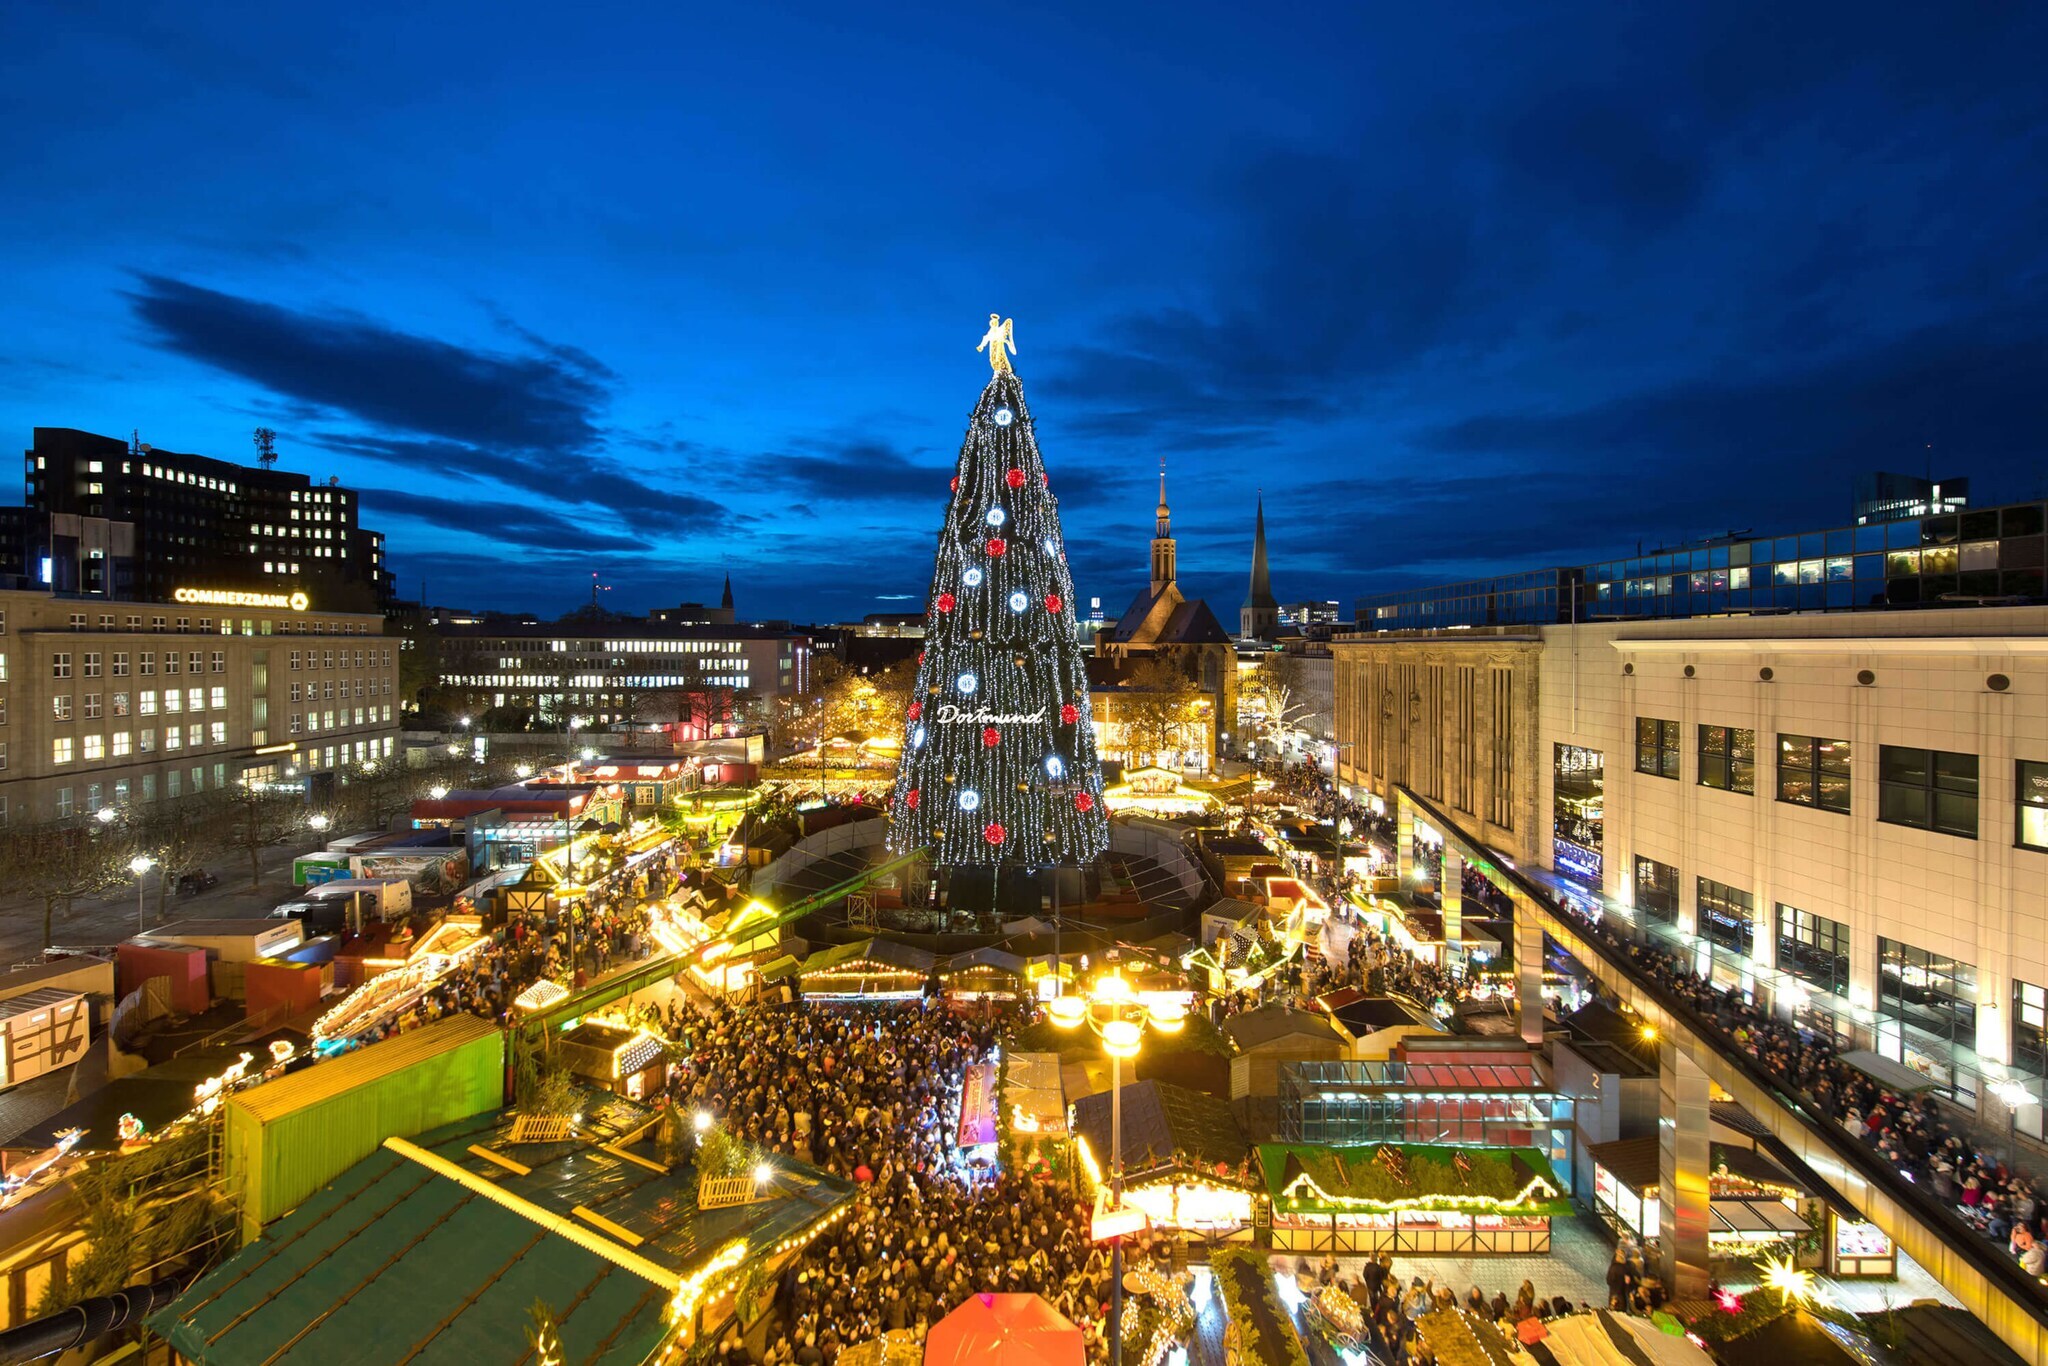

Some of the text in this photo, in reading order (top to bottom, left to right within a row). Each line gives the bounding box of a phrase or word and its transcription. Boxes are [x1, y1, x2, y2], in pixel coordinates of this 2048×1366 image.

[175, 588, 289, 607] COMMERZBANK
[937, 705, 1046, 724] Dortmund
[1592, 1072, 1600, 1089] 2
